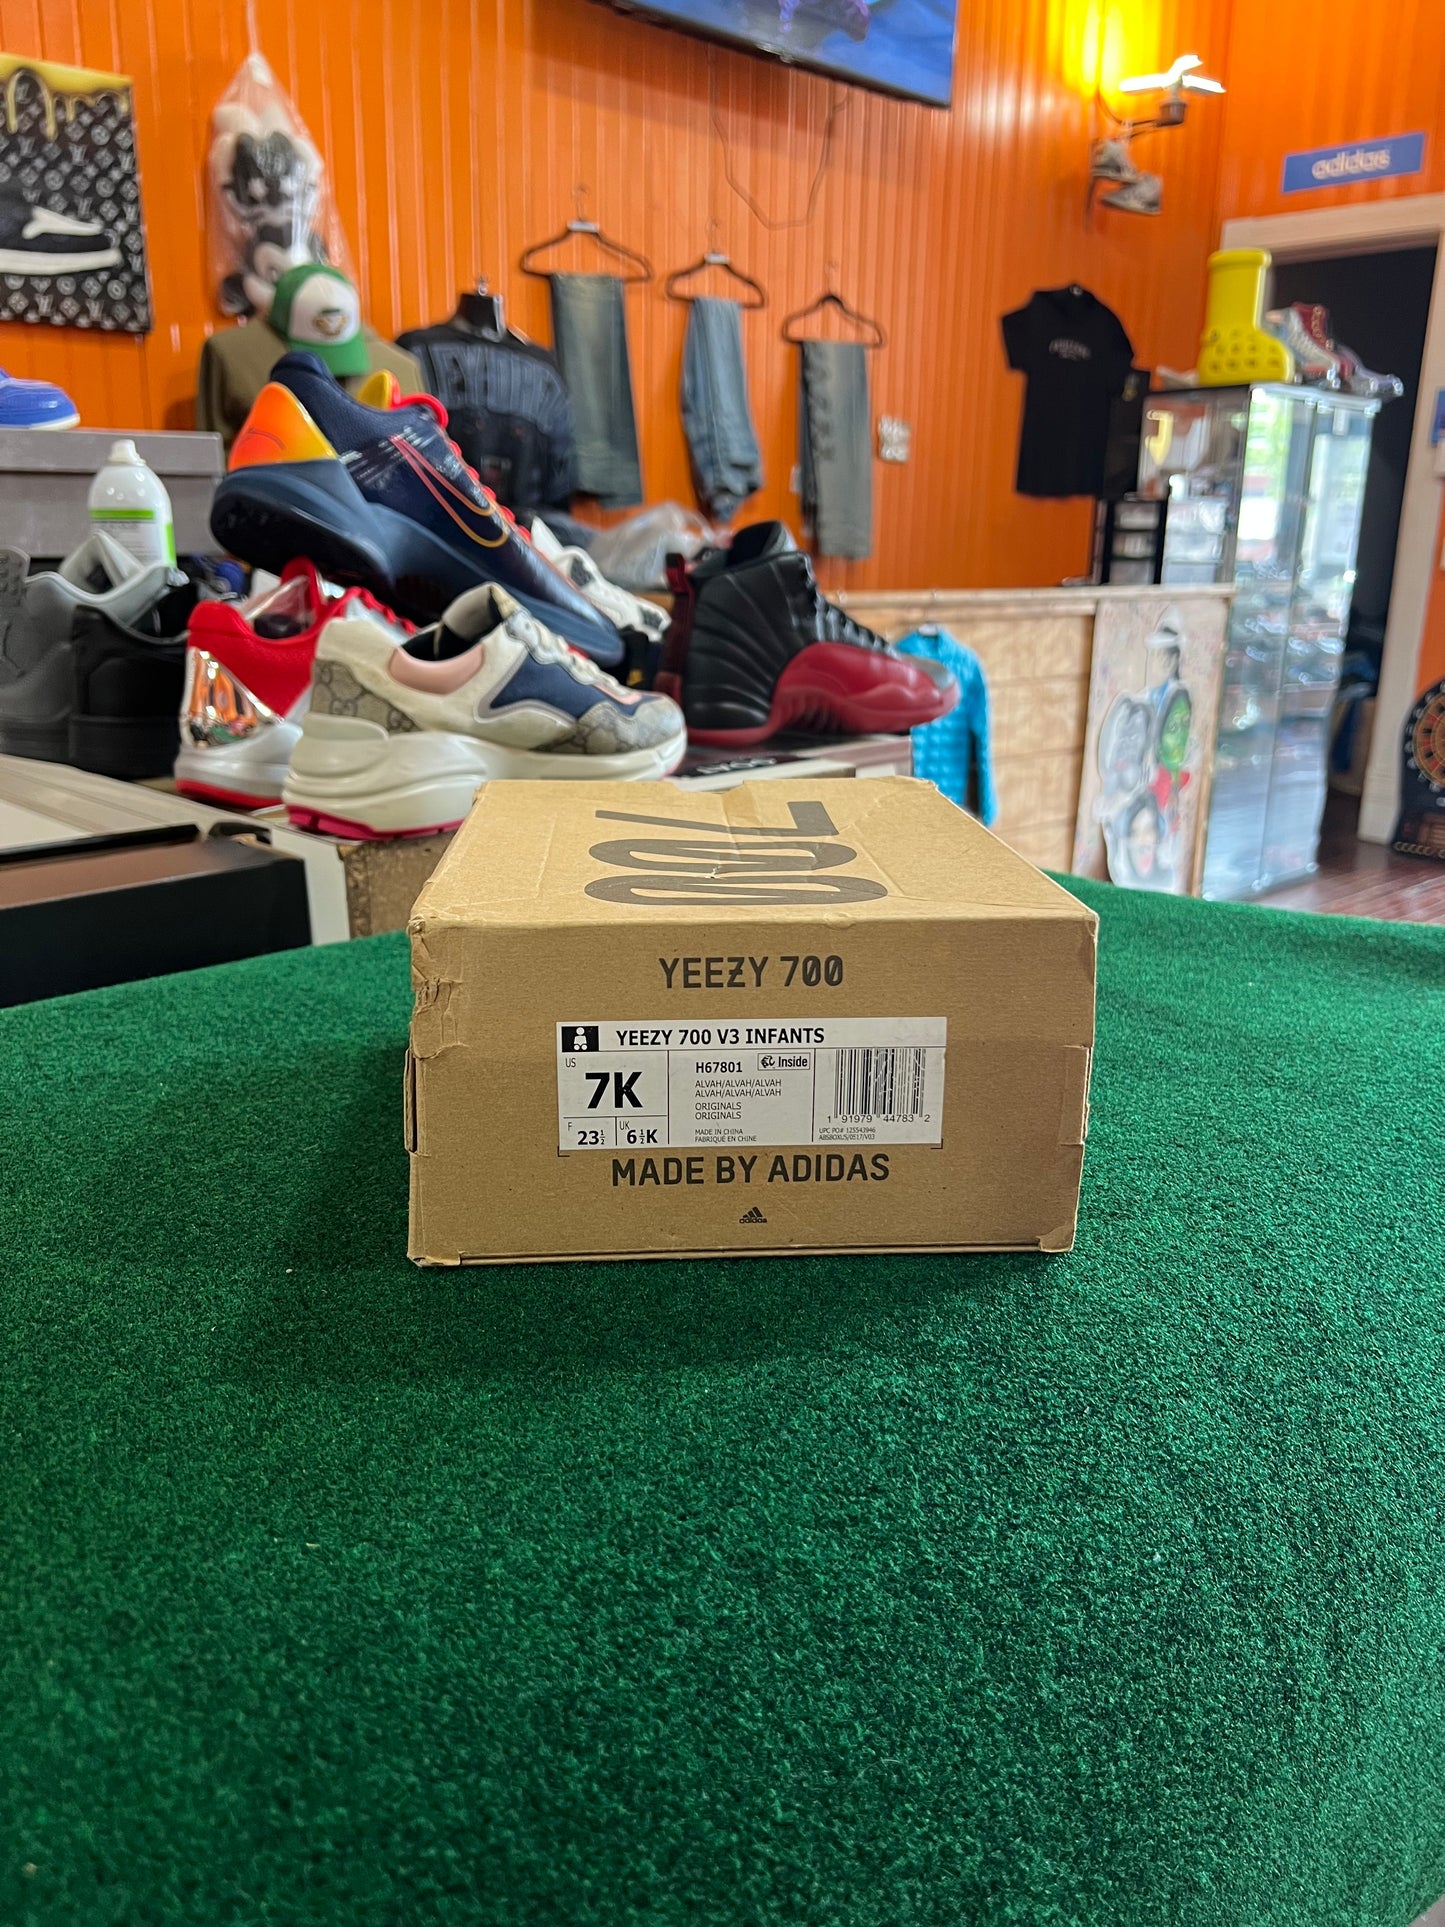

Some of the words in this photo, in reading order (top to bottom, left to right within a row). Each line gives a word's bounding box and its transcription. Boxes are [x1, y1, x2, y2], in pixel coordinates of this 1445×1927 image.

[1311, 148, 1391, 180] adidas
[583, 800, 889, 906] 700
[658, 956, 769, 989] YEEZY
[779, 955, 844, 987] 700
[616, 1030, 673, 1046] YEEZY
[678, 1029, 712, 1045] 700
[717, 1029, 740, 1044] V3
[745, 1027, 825, 1044] INFANTS
[565, 1058, 576, 1068] US
[778, 1056, 808, 1068] Inside
[695, 1062, 743, 1073] H67801
[695, 1079, 782, 1089] ALVAH/ALVAH/ALVAH
[585, 1071, 643, 1109] 7K
[695, 1089, 782, 1098] ALVAH/ALVAH/ALVAH
[695, 1102, 742, 1111] ORIGINALS
[695, 1111, 742, 1120] ORIGINALS
[567, 1122, 573, 1131] F
[619, 1121, 630, 1130] UK
[612, 1156, 705, 1187] MADE
[716, 1155, 758, 1184] BY
[767, 1153, 890, 1183] ADIDAS
[738, 1216, 768, 1224] adidas
